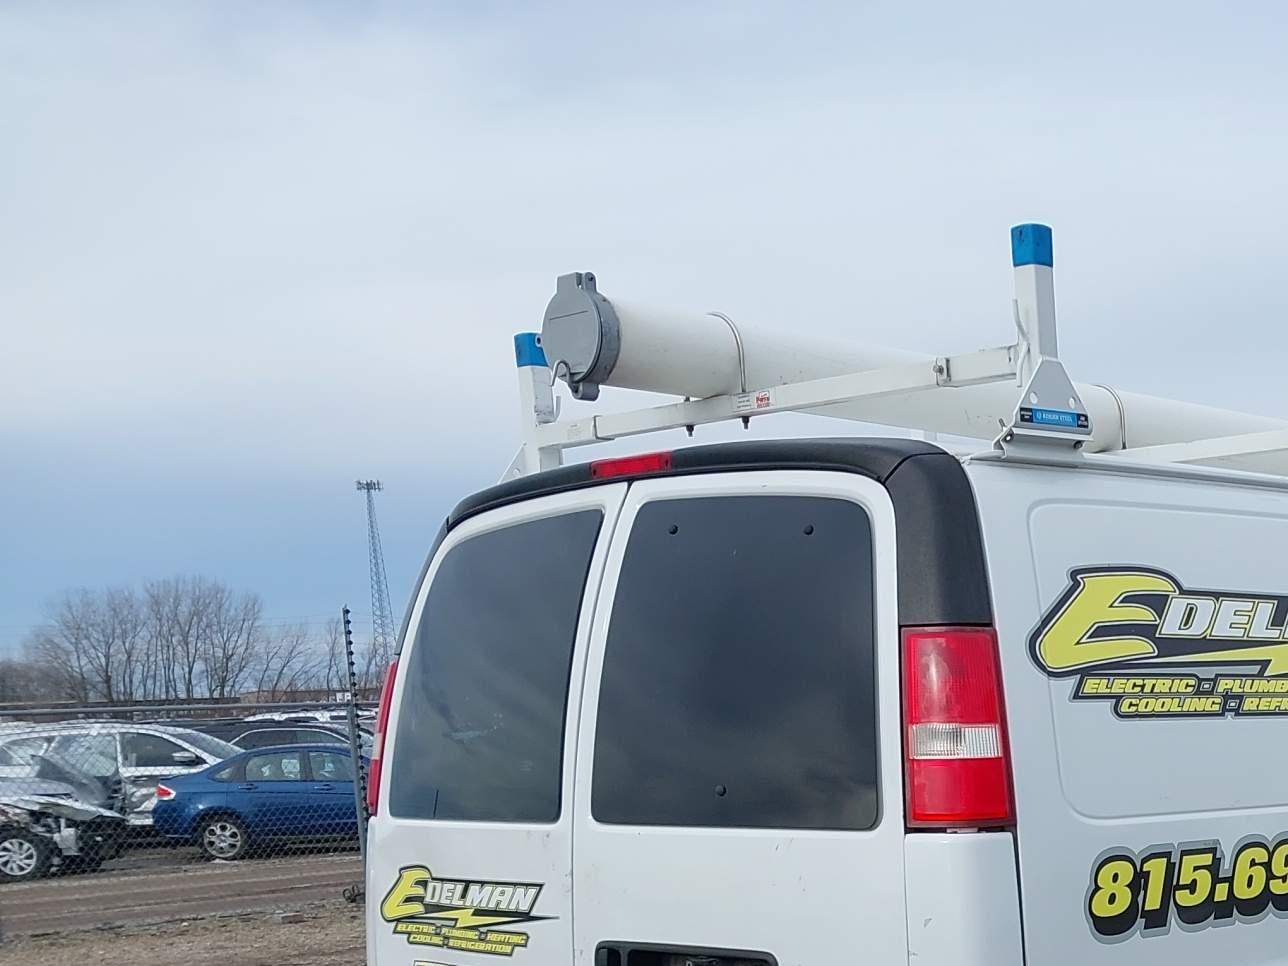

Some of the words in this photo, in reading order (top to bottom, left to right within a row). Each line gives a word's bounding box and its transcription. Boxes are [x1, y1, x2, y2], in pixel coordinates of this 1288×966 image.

[1082, 676, 1196, 694] ELECTRIC
[1119, 695, 1222, 714] COOLING
[382, 869, 538, 920] EDELMAN
[397, 922, 436, 934] ELECTRIC
